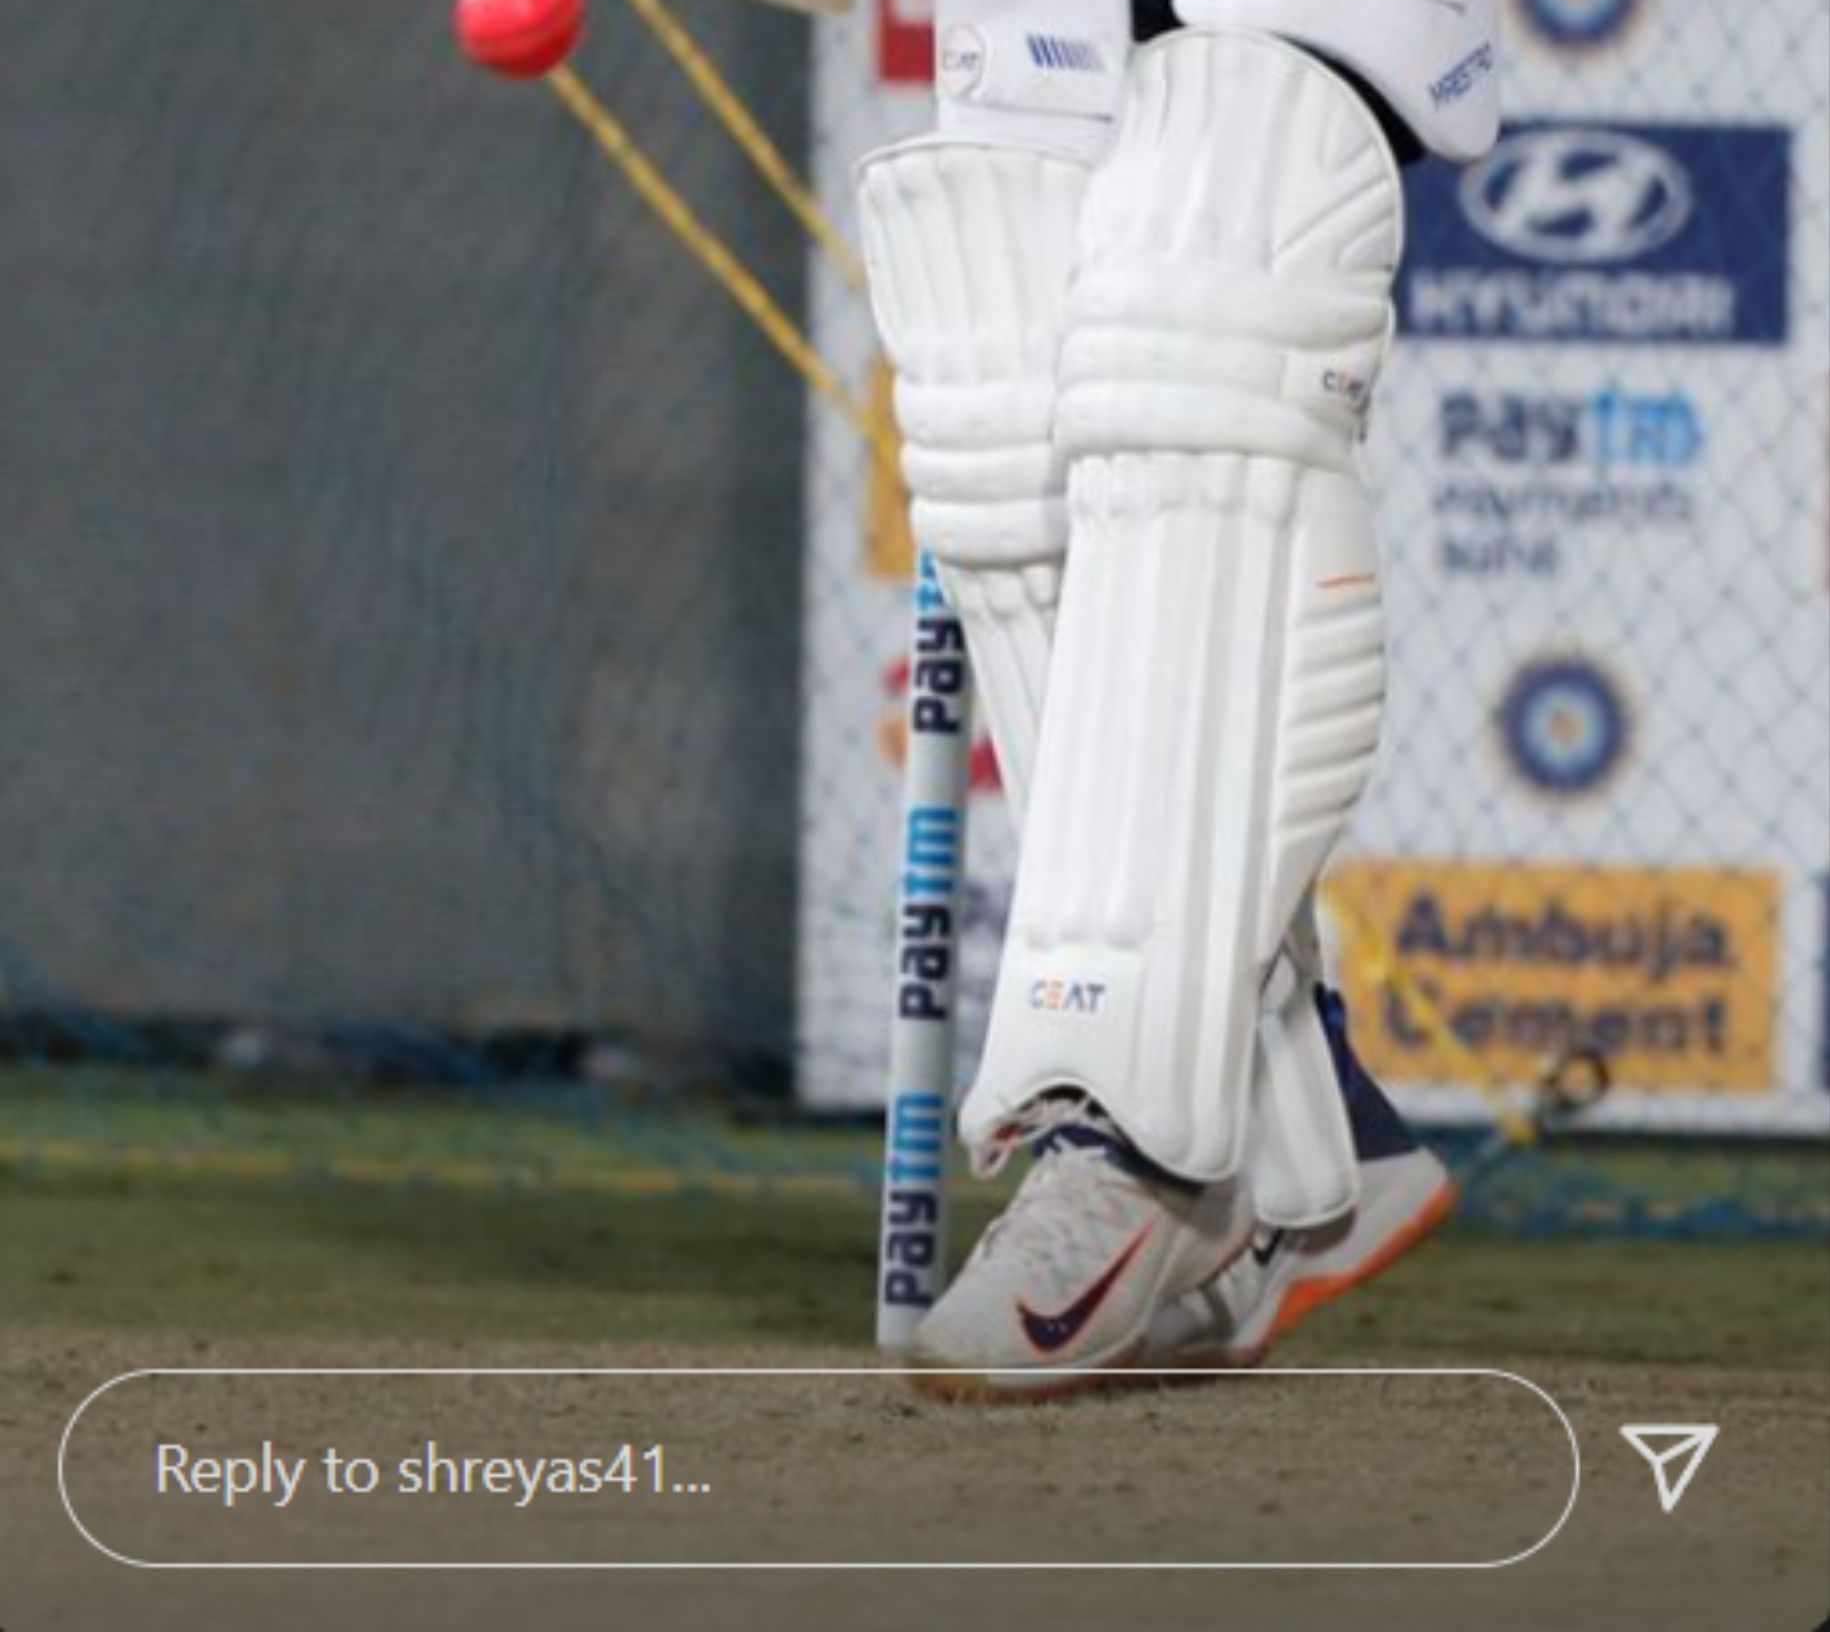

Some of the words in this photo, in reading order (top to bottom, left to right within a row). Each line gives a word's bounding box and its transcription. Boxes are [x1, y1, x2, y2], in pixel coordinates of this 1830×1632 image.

[1410, 270, 1735, 334] HYUNDAI
[1398, 894, 1738, 984] Ambuja
[1029, 977, 1105, 1013] CEAT
